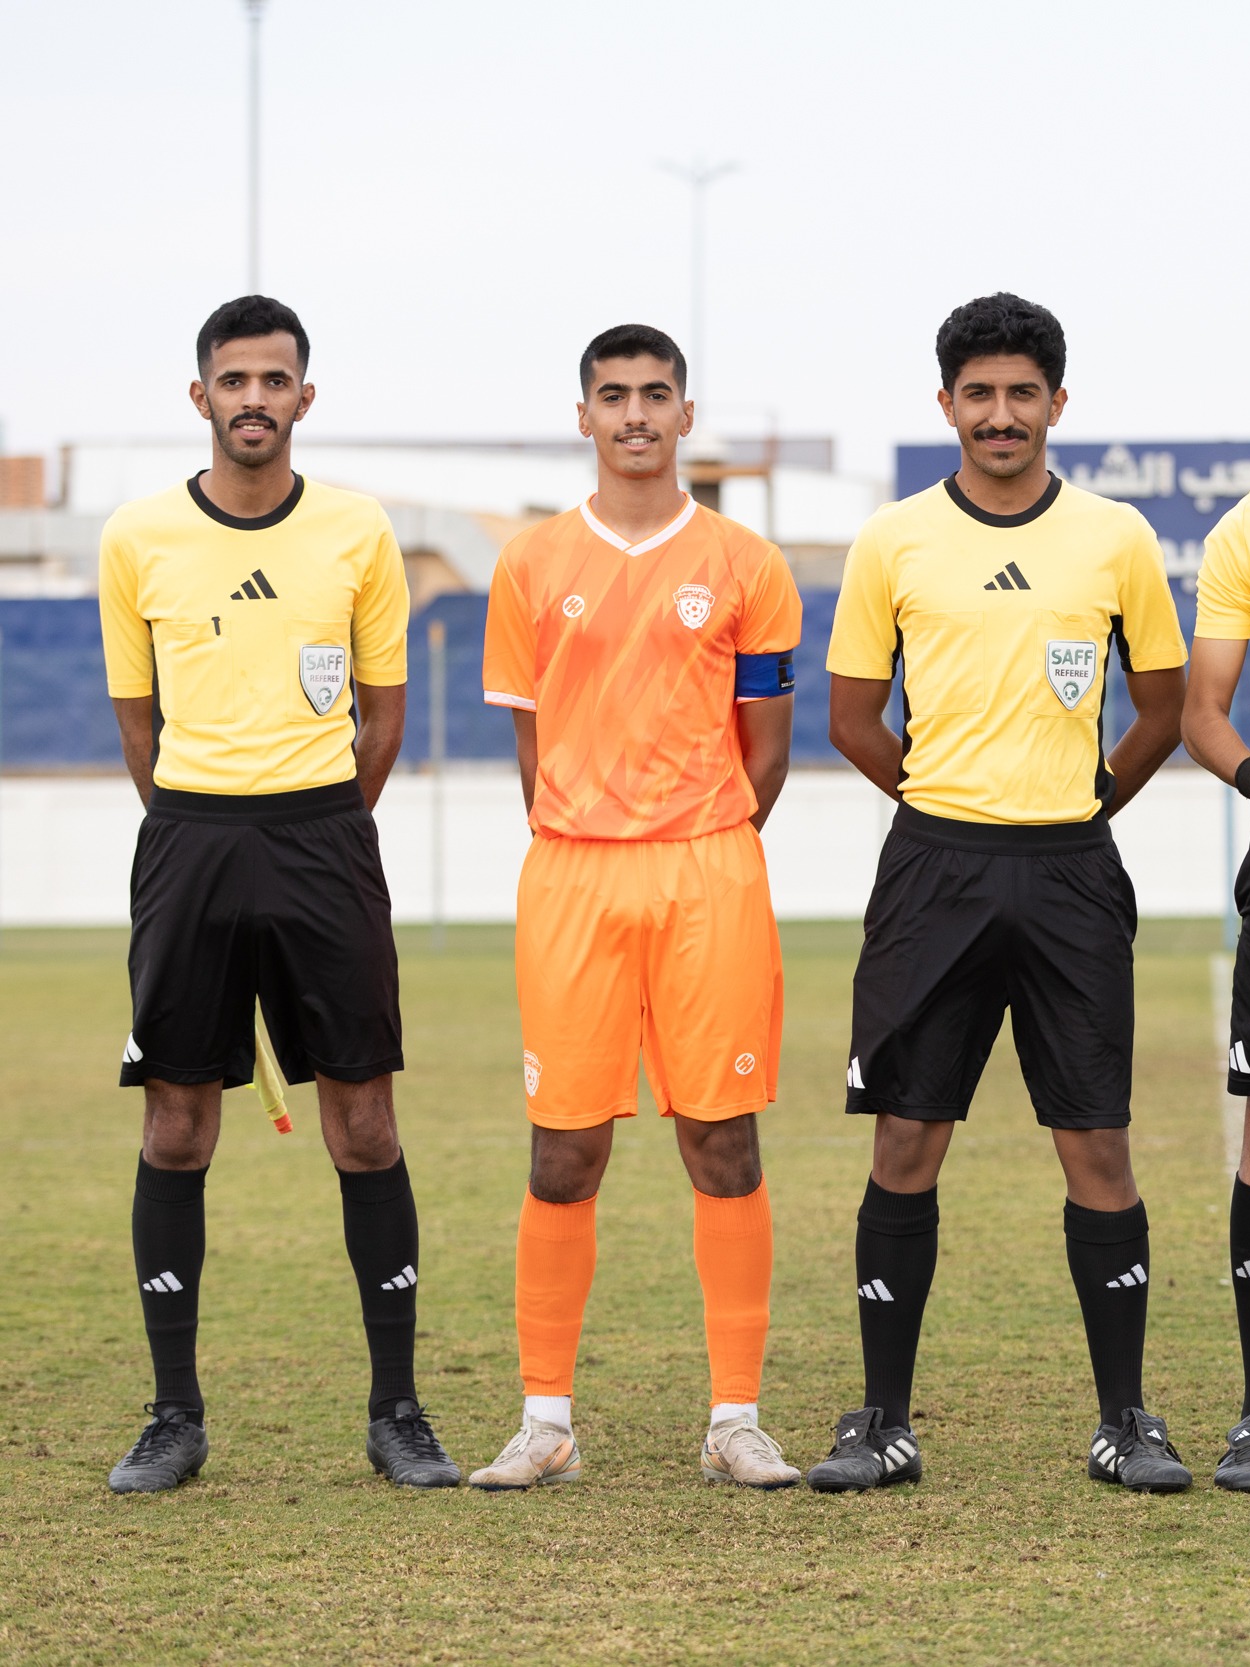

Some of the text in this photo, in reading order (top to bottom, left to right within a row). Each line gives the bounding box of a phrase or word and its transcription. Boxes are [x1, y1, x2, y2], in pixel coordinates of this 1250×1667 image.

[305, 654, 343, 671] SAFF
[1051, 648, 1094, 666] SAFF
[309, 674, 340, 683] REFEREE
[1054, 668, 1089, 678] REFEREE
